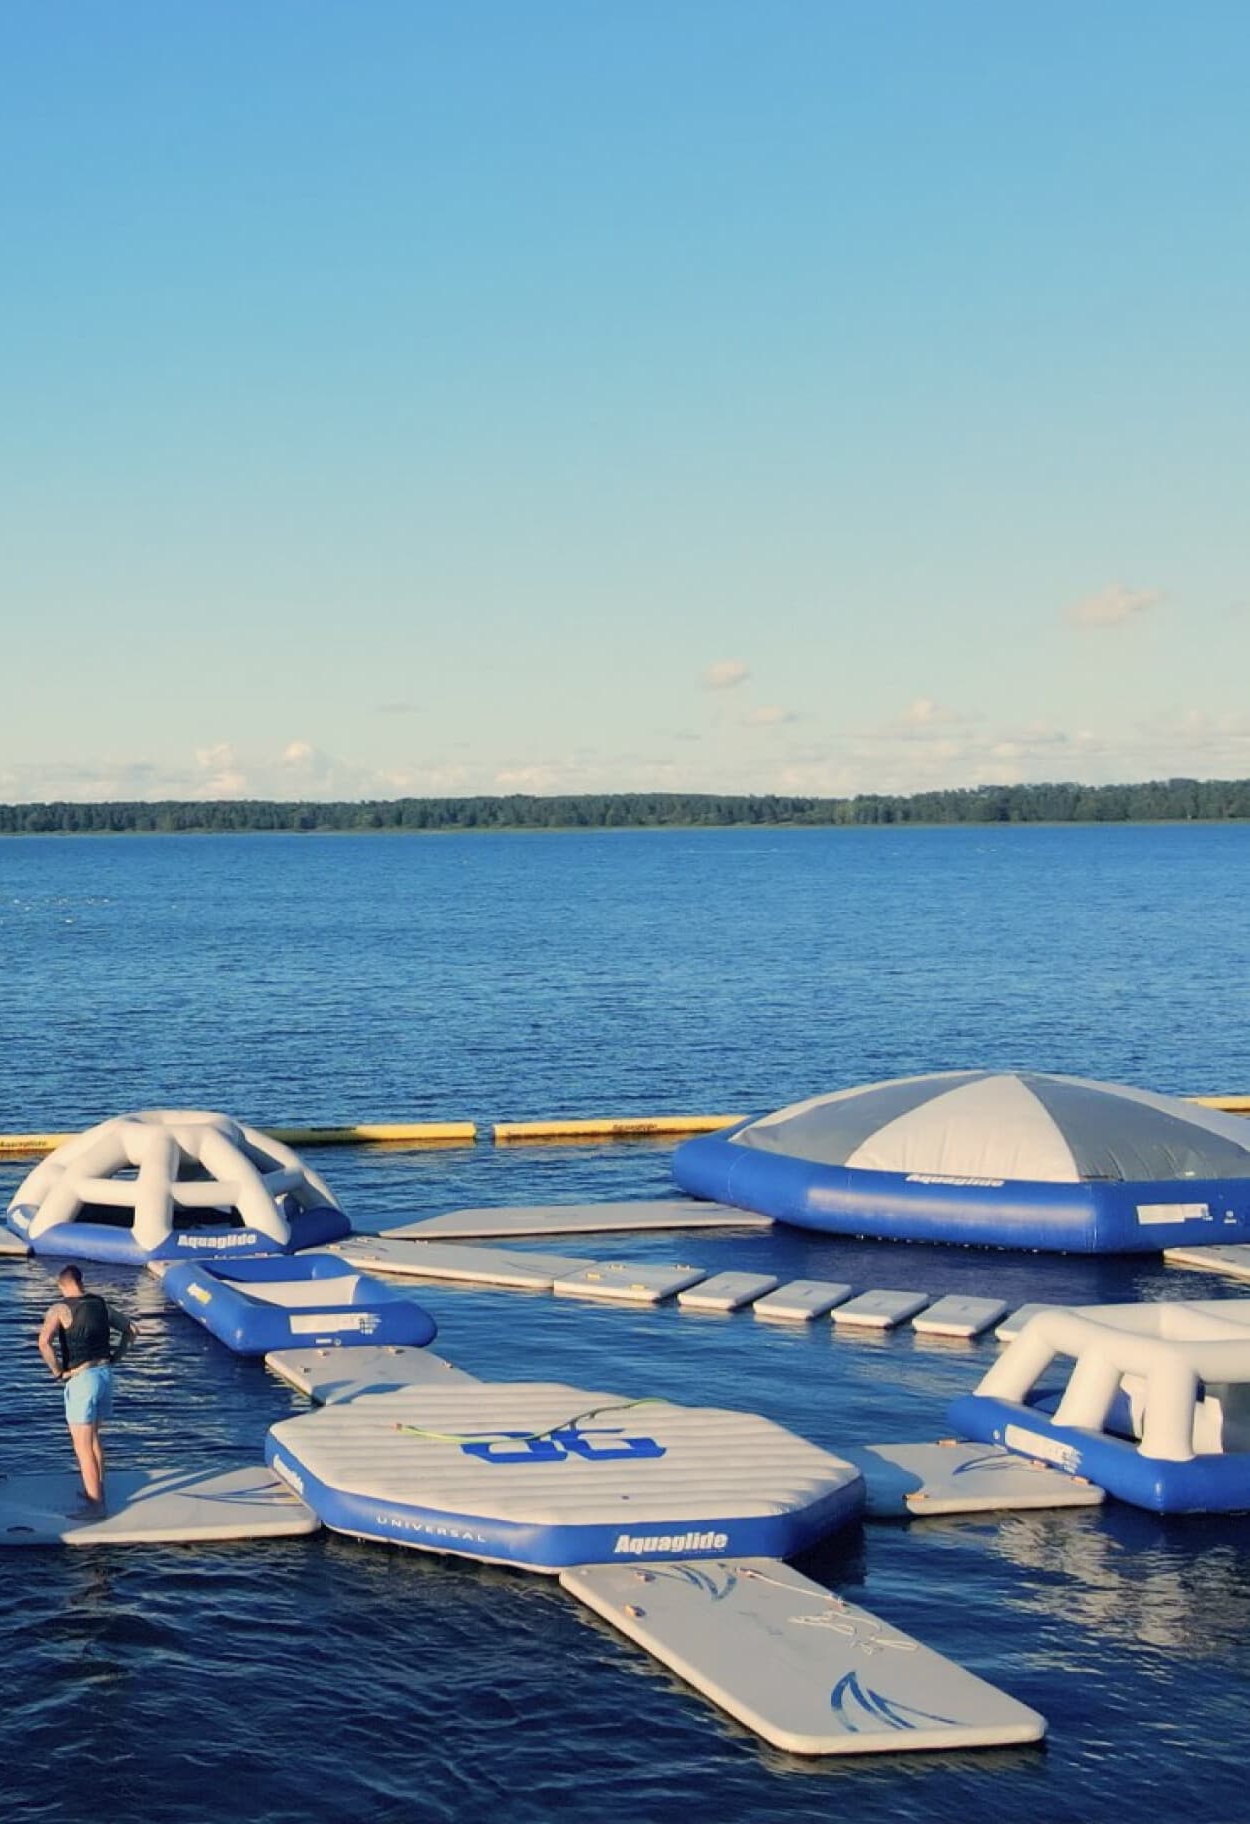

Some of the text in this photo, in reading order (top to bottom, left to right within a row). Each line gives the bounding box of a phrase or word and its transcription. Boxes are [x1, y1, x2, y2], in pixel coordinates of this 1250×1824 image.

[177, 1233, 257, 1249] Aquaglide
[376, 1515, 487, 1543] UNIVERSAL
[614, 1531, 729, 1555] Aquaglide
